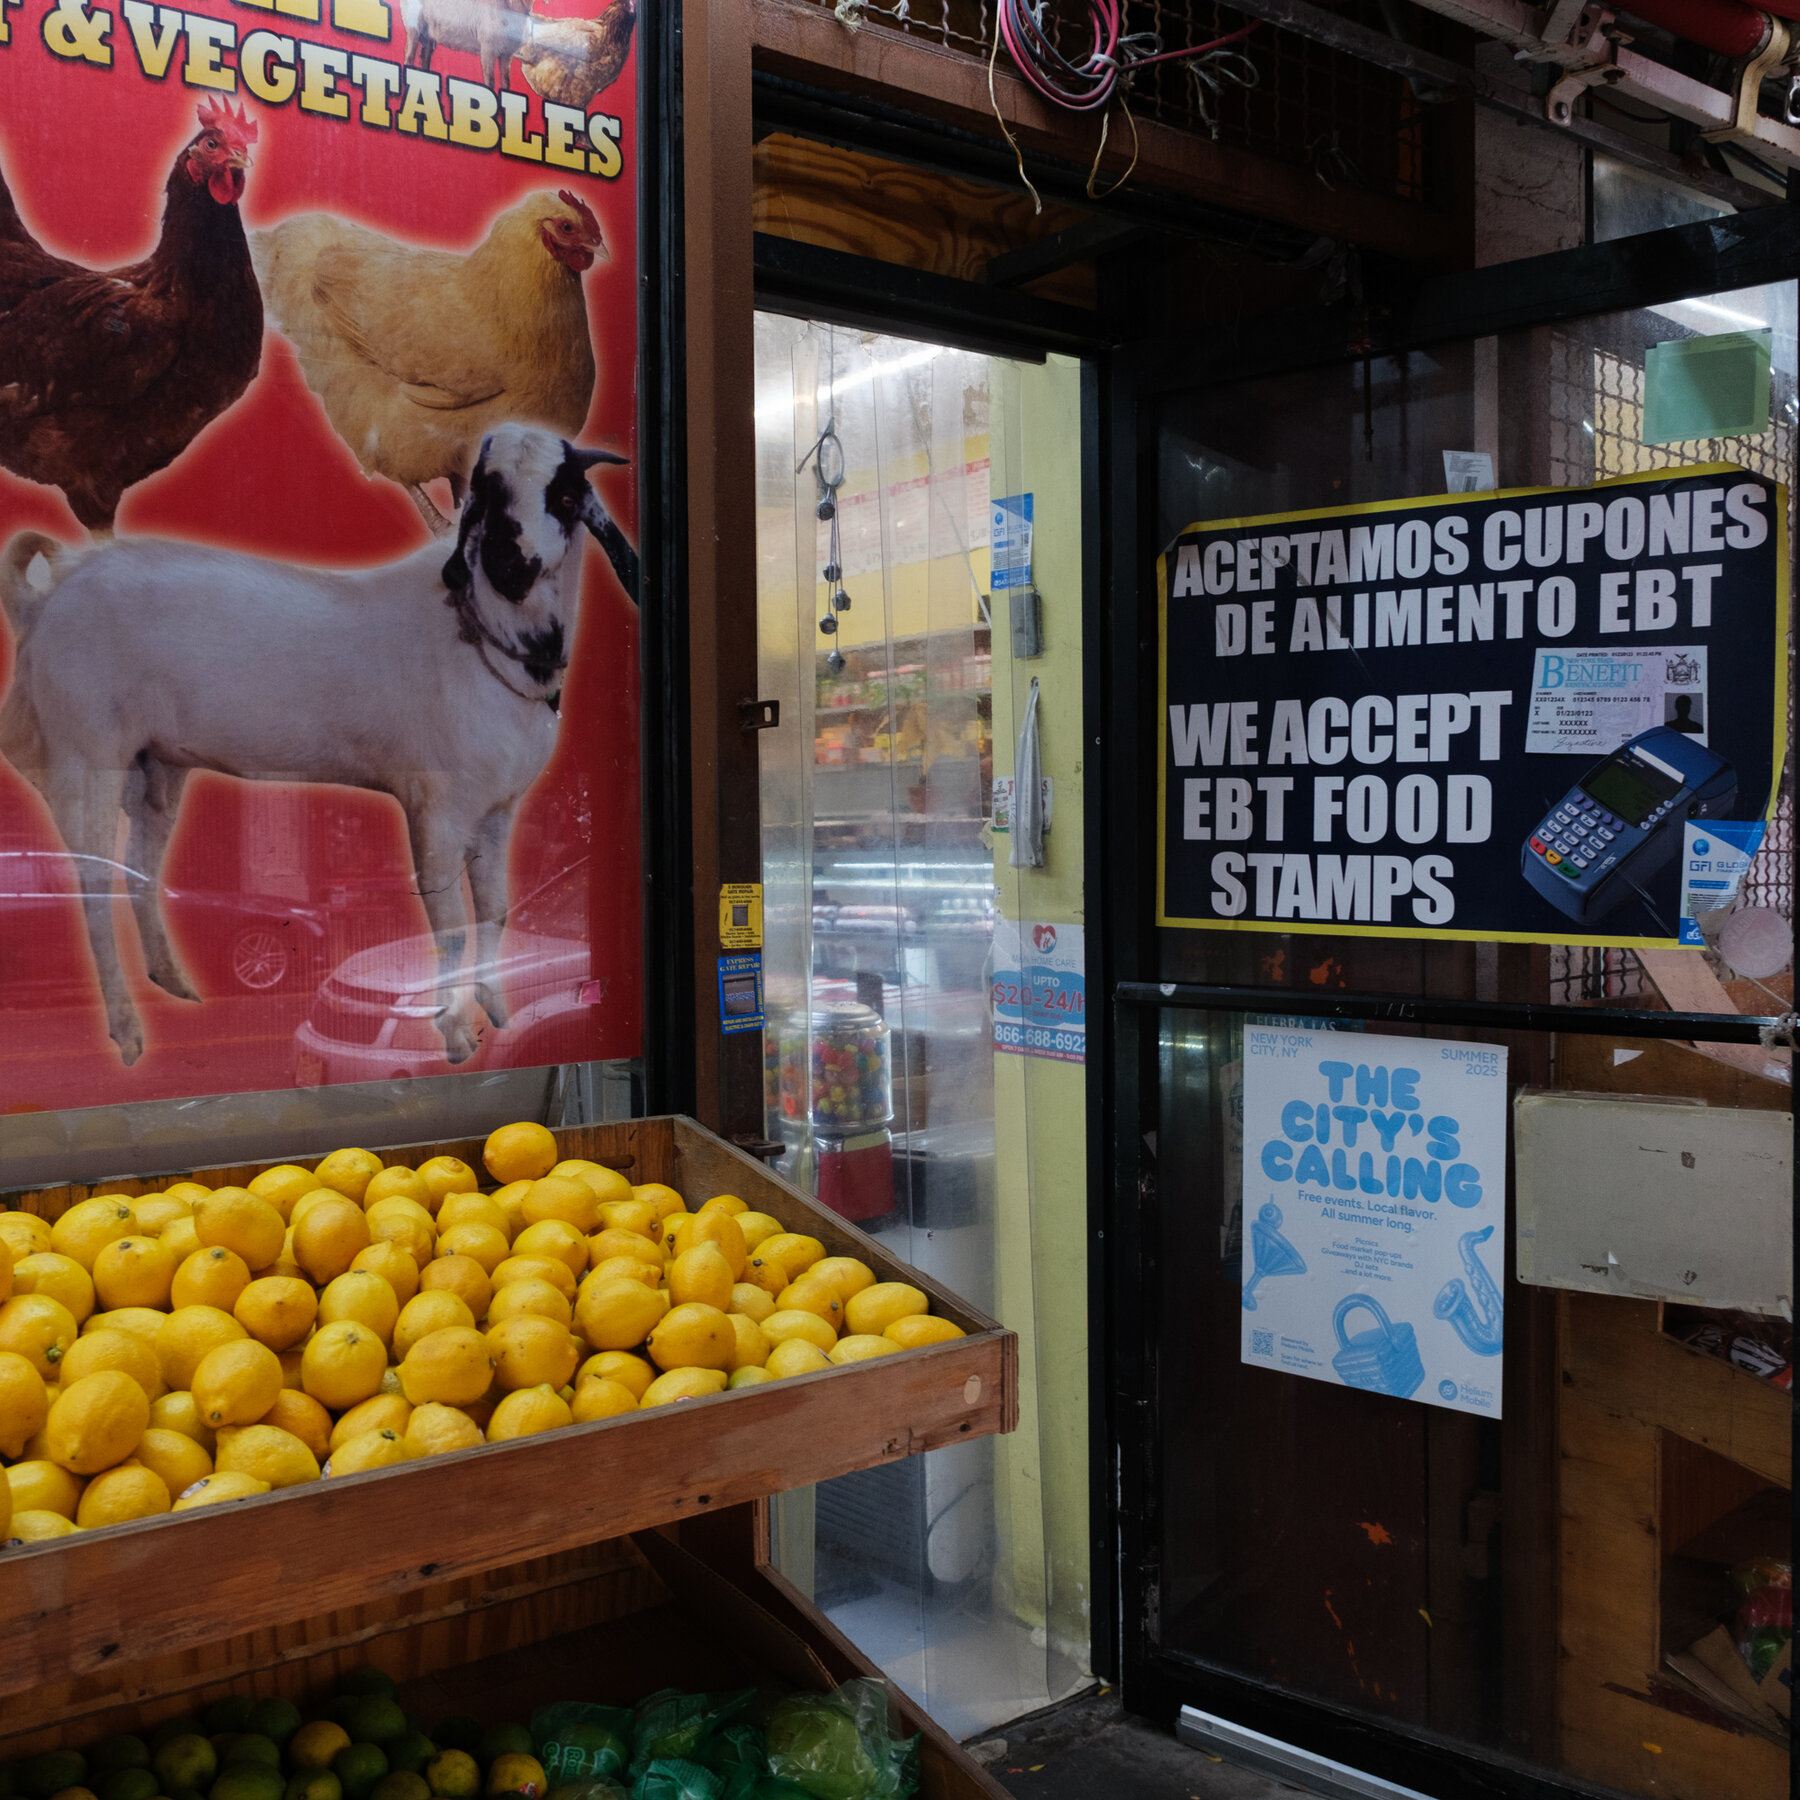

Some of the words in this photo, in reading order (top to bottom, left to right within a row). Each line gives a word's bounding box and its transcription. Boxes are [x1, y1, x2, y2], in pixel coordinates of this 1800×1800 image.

[42, 0, 114, 67] &
[121, 0, 625, 180] VEGETABLES
[1172, 515, 1469, 598] ACEPTAMOS
[1482, 483, 1769, 572] CUPONES
[1215, 602, 1276, 657] DE
[1289, 575, 1576, 653] ALIMENTO
[1600, 563, 1723, 634] EBT
[1538, 655, 1643, 689] BENEFIT
[1169, 699, 1258, 767] WE
[1267, 690, 1512, 765] ACCEPT
[1183, 777, 1294, 841] EBT
[1313, 773, 1493, 844] FOOD
[1689, 860, 1712, 872] GFI
[1210, 851, 1456, 925] STAMPS
[1055, 958, 1077, 968] CARE
[1033, 975, 1061, 988] UPTO
[1250, 1032, 1278, 1045] NEW
[1280, 1034, 1313, 1048] YORK
[1250, 1044, 1280, 1058] CITY,
[1282, 1046, 1298, 1058] NY
[1441, 1048, 1499, 1064] SUMMER
[1465, 1063, 1498, 1077] 2025
[1319, 1060, 1421, 1111] THE
[1281, 1099, 1461, 1161] CITY'S
[1261, 1140, 1483, 1209] CALLING
[1298, 1190, 1322, 1203] Free
[1324, 1194, 1365, 1210] events.
[1368, 1200, 1398, 1215] Local
[1400, 1205, 1438, 1221] flavor.
[1321, 1207, 1335, 1219] All
[1338, 1212, 1384, 1226] summer
[1386, 1217, 1415, 1233] long.
[1332, 1241, 1349, 1250] Food
[1350, 1244, 1373, 1255] market
[1374, 1248, 1402, 1259] pop-ups
[1355, 1237, 1379, 1247] Picnics
[1320, 1247, 1356, 1261] Giveaways
[1357, 1252, 1373, 1262] with
[1373, 1256, 1390, 1265] NYC
[1390, 1259, 1414, 1269] brands
[1365, 1263, 1379, 1271] sets
[1460, 1384, 1493, 1398] Helium
[1460, 1394, 1491, 1408] Mobile
